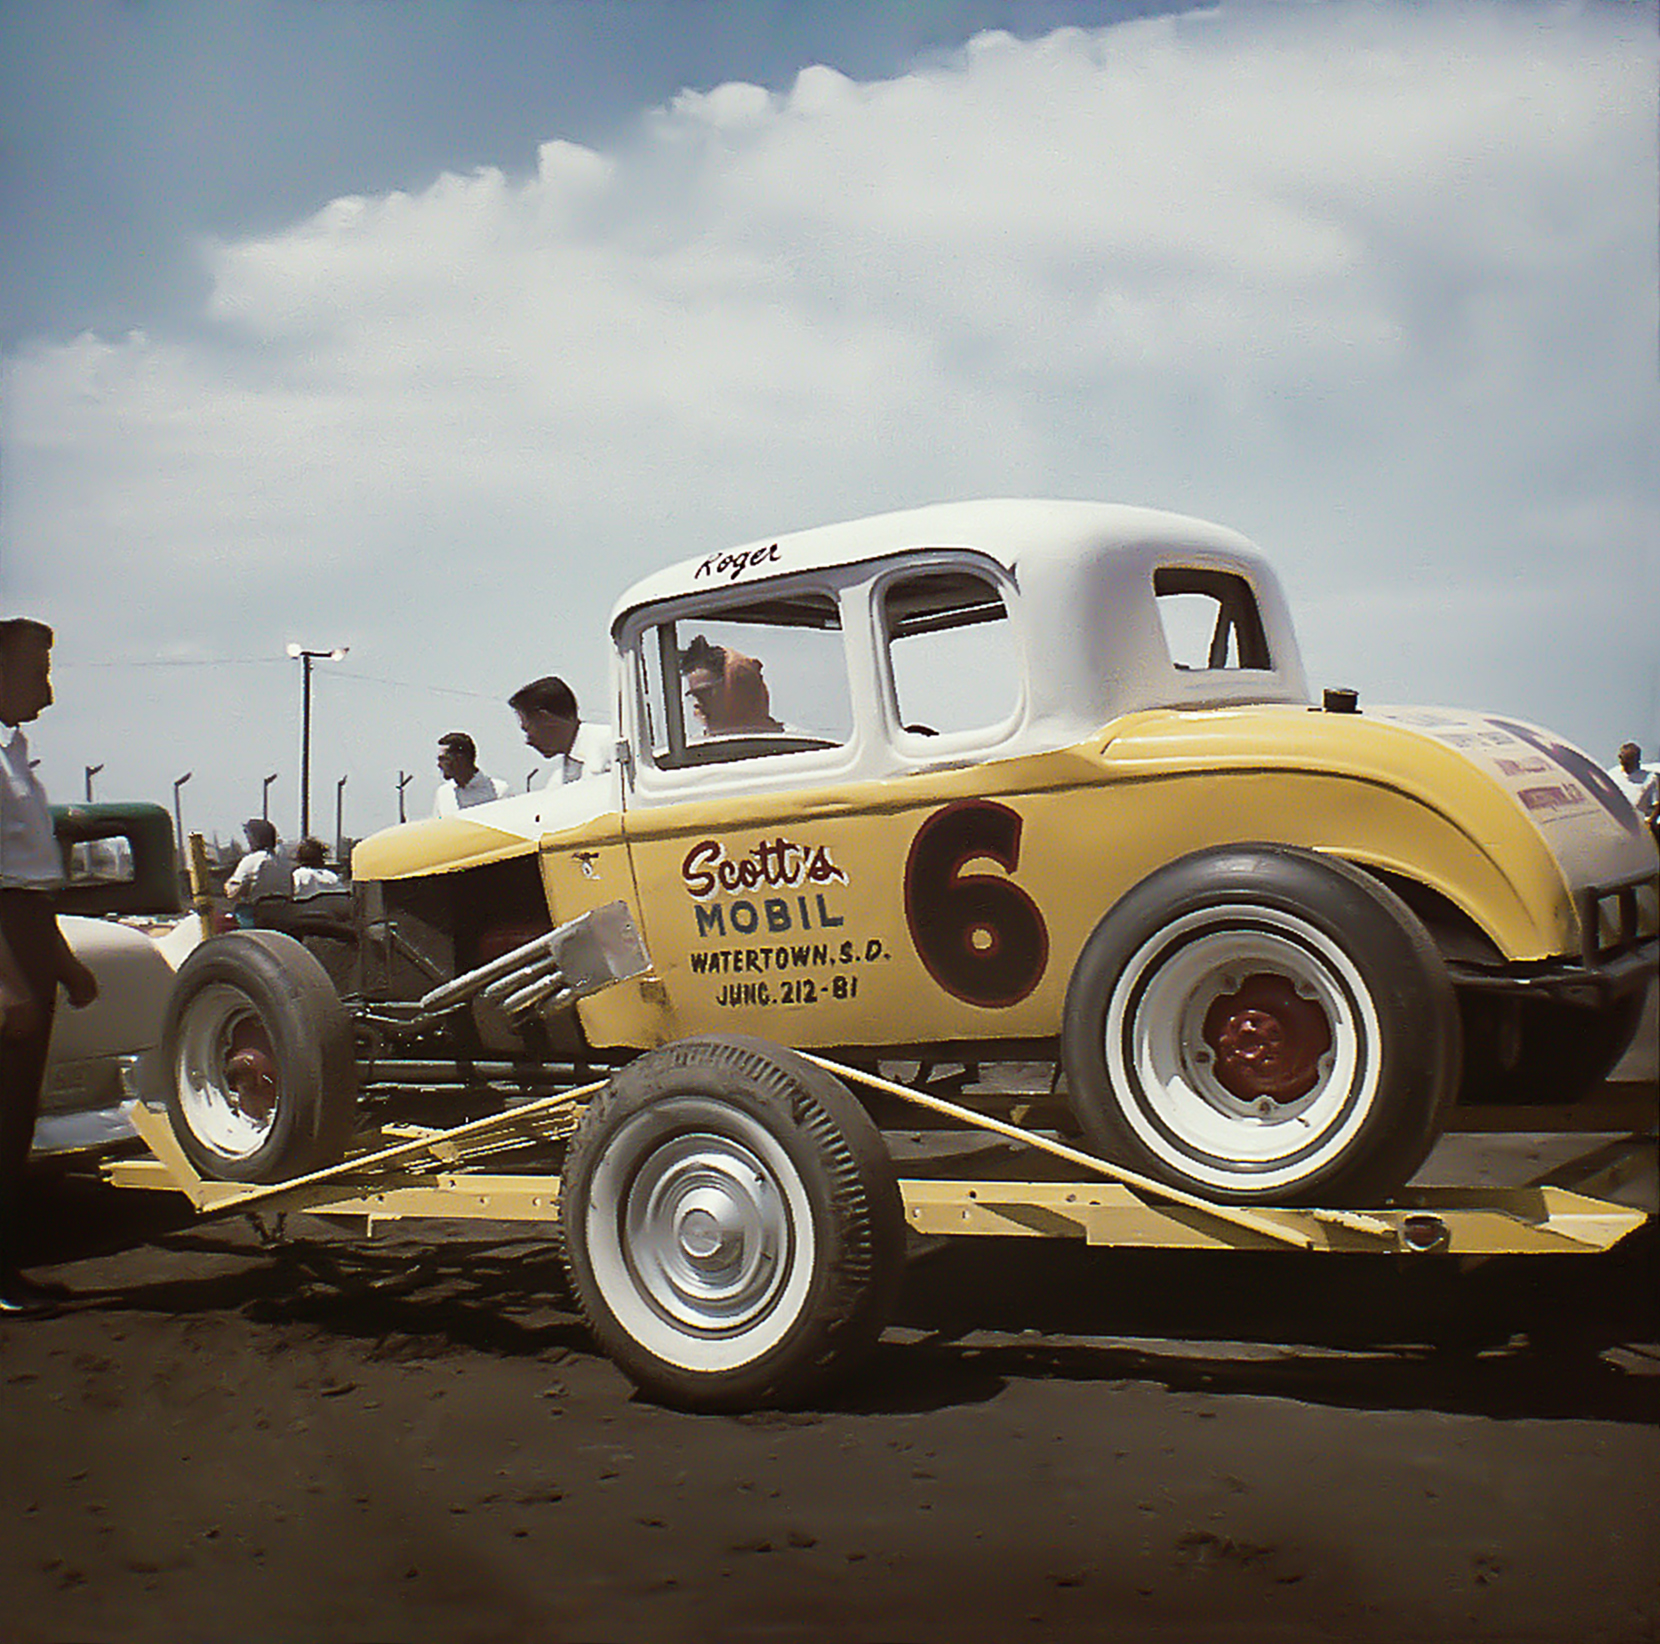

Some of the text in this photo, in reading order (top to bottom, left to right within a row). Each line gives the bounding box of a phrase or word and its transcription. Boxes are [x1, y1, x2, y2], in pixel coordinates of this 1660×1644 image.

[694, 543, 782, 580] Roger
[682, 838, 849, 901] Scott's
[694, 893, 844, 937] MOBIL
[904, 799, 1050, 1009] 6
